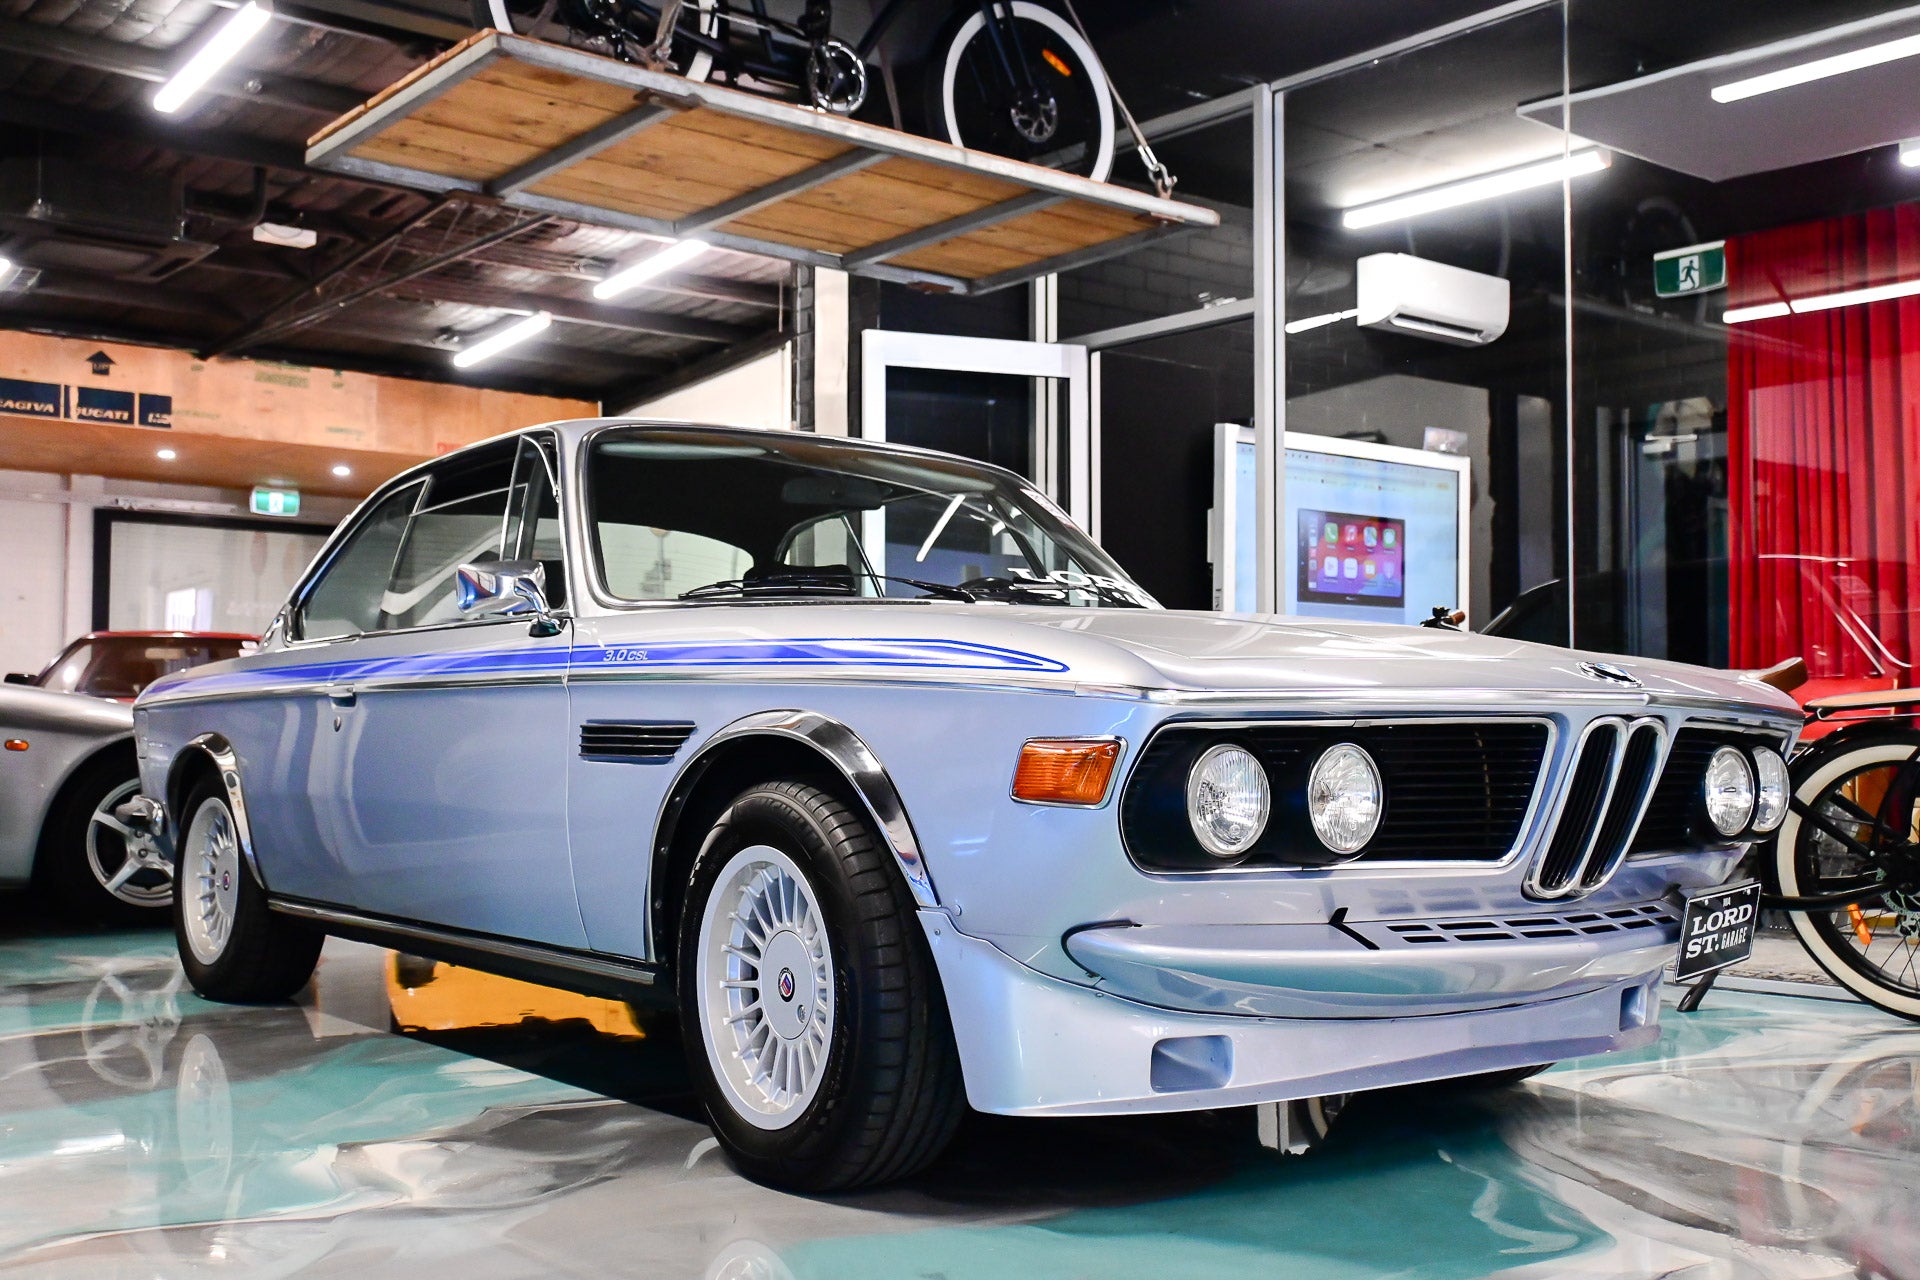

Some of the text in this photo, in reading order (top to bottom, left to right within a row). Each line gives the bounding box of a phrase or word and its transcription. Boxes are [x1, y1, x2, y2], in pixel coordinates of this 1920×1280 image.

[603, 650, 649, 661] 3.0 CSL
[1691, 904, 1752, 936] LORD
[1685, 927, 1748, 959] ST. GARAGE
